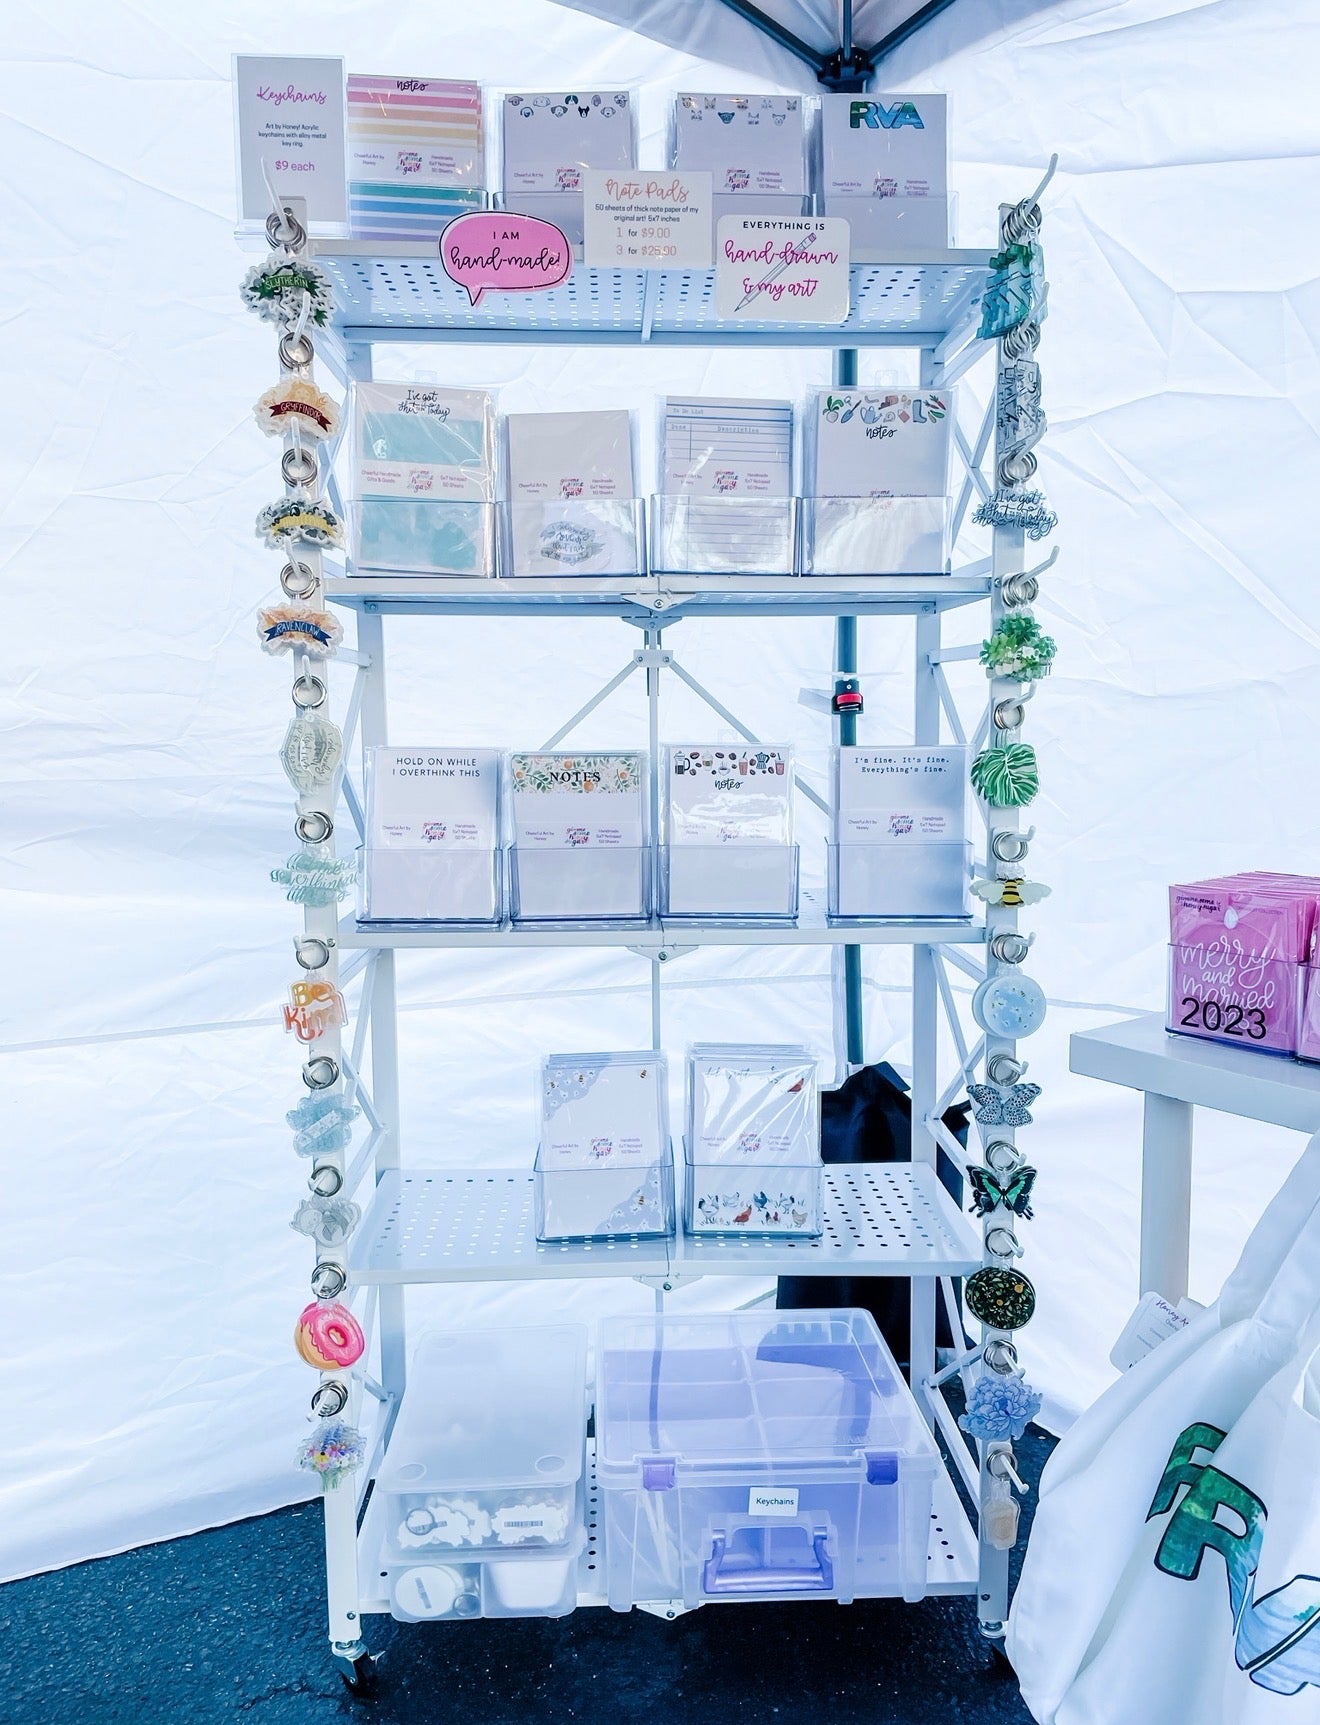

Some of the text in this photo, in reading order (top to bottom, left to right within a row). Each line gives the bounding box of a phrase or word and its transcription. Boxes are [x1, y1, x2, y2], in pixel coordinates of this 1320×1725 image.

[397, 80, 428, 92] notes
[257, 85, 326, 105] Keychains
[850, 101, 925, 130] RVA
[275, 160, 315, 171] $9 each
[605, 179, 689, 203] Note Pads
[614, 215, 635, 223] original
[743, 221, 811, 230] EVERYTHING
[502, 231, 520, 240] AM
[616, 227, 671, 238] 1 for $9.00
[616, 244, 623, 255] 3
[642, 245, 677, 256] $25.00
[725, 239, 838, 264] hand-drawn
[450, 246, 560, 271] hand-made!
[265, 276, 308, 289] SLYTHERIN
[743, 278, 753, 294] &
[757, 282, 785, 301] my
[281, 402, 321, 420] GRYFFINDOR
[866, 424, 898, 439] notes
[276, 622, 319, 635] RAVENCLAW
[396, 757, 477, 766] HOLD ON WHILE
[400, 769, 455, 777] OVERTHINK
[459, 769, 480, 777] THIS
[550, 771, 601, 782] NOTES
[714, 778, 744, 790] notes
[1181, 935, 1277, 989] merry
[1202, 967, 1235, 987] and
[293, 983, 333, 1006] Be
[1182, 974, 1275, 1009] married
[1180, 998, 1267, 1040] 2023
[756, 1498, 794, 1506] Keychains
